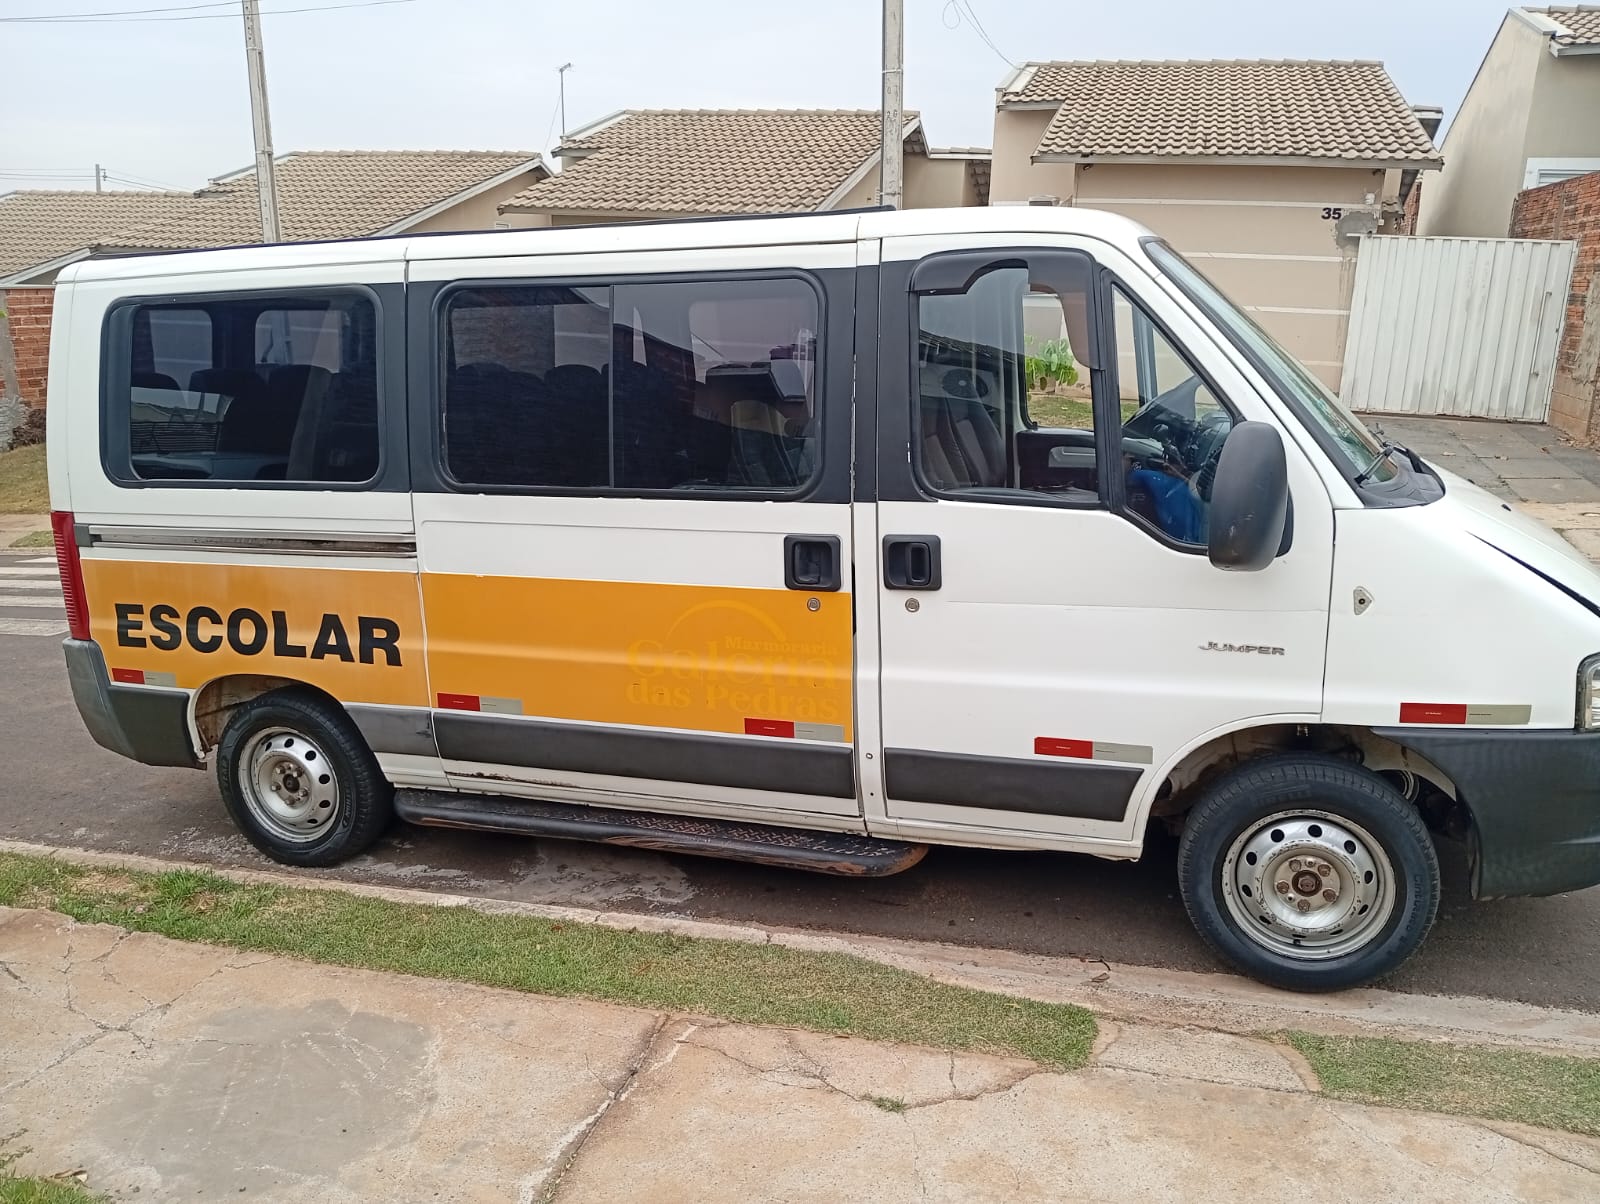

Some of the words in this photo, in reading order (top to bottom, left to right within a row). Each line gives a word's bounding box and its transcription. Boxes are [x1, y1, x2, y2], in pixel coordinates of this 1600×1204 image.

[1321, 207, 1342, 220] 35
[114, 603, 403, 667] ESCOLAR
[1198, 641, 1285, 656] JUMPER
[626, 639, 835, 690] Galeria
[625, 678, 693, 708] das
[704, 684, 840, 720] Pedras
